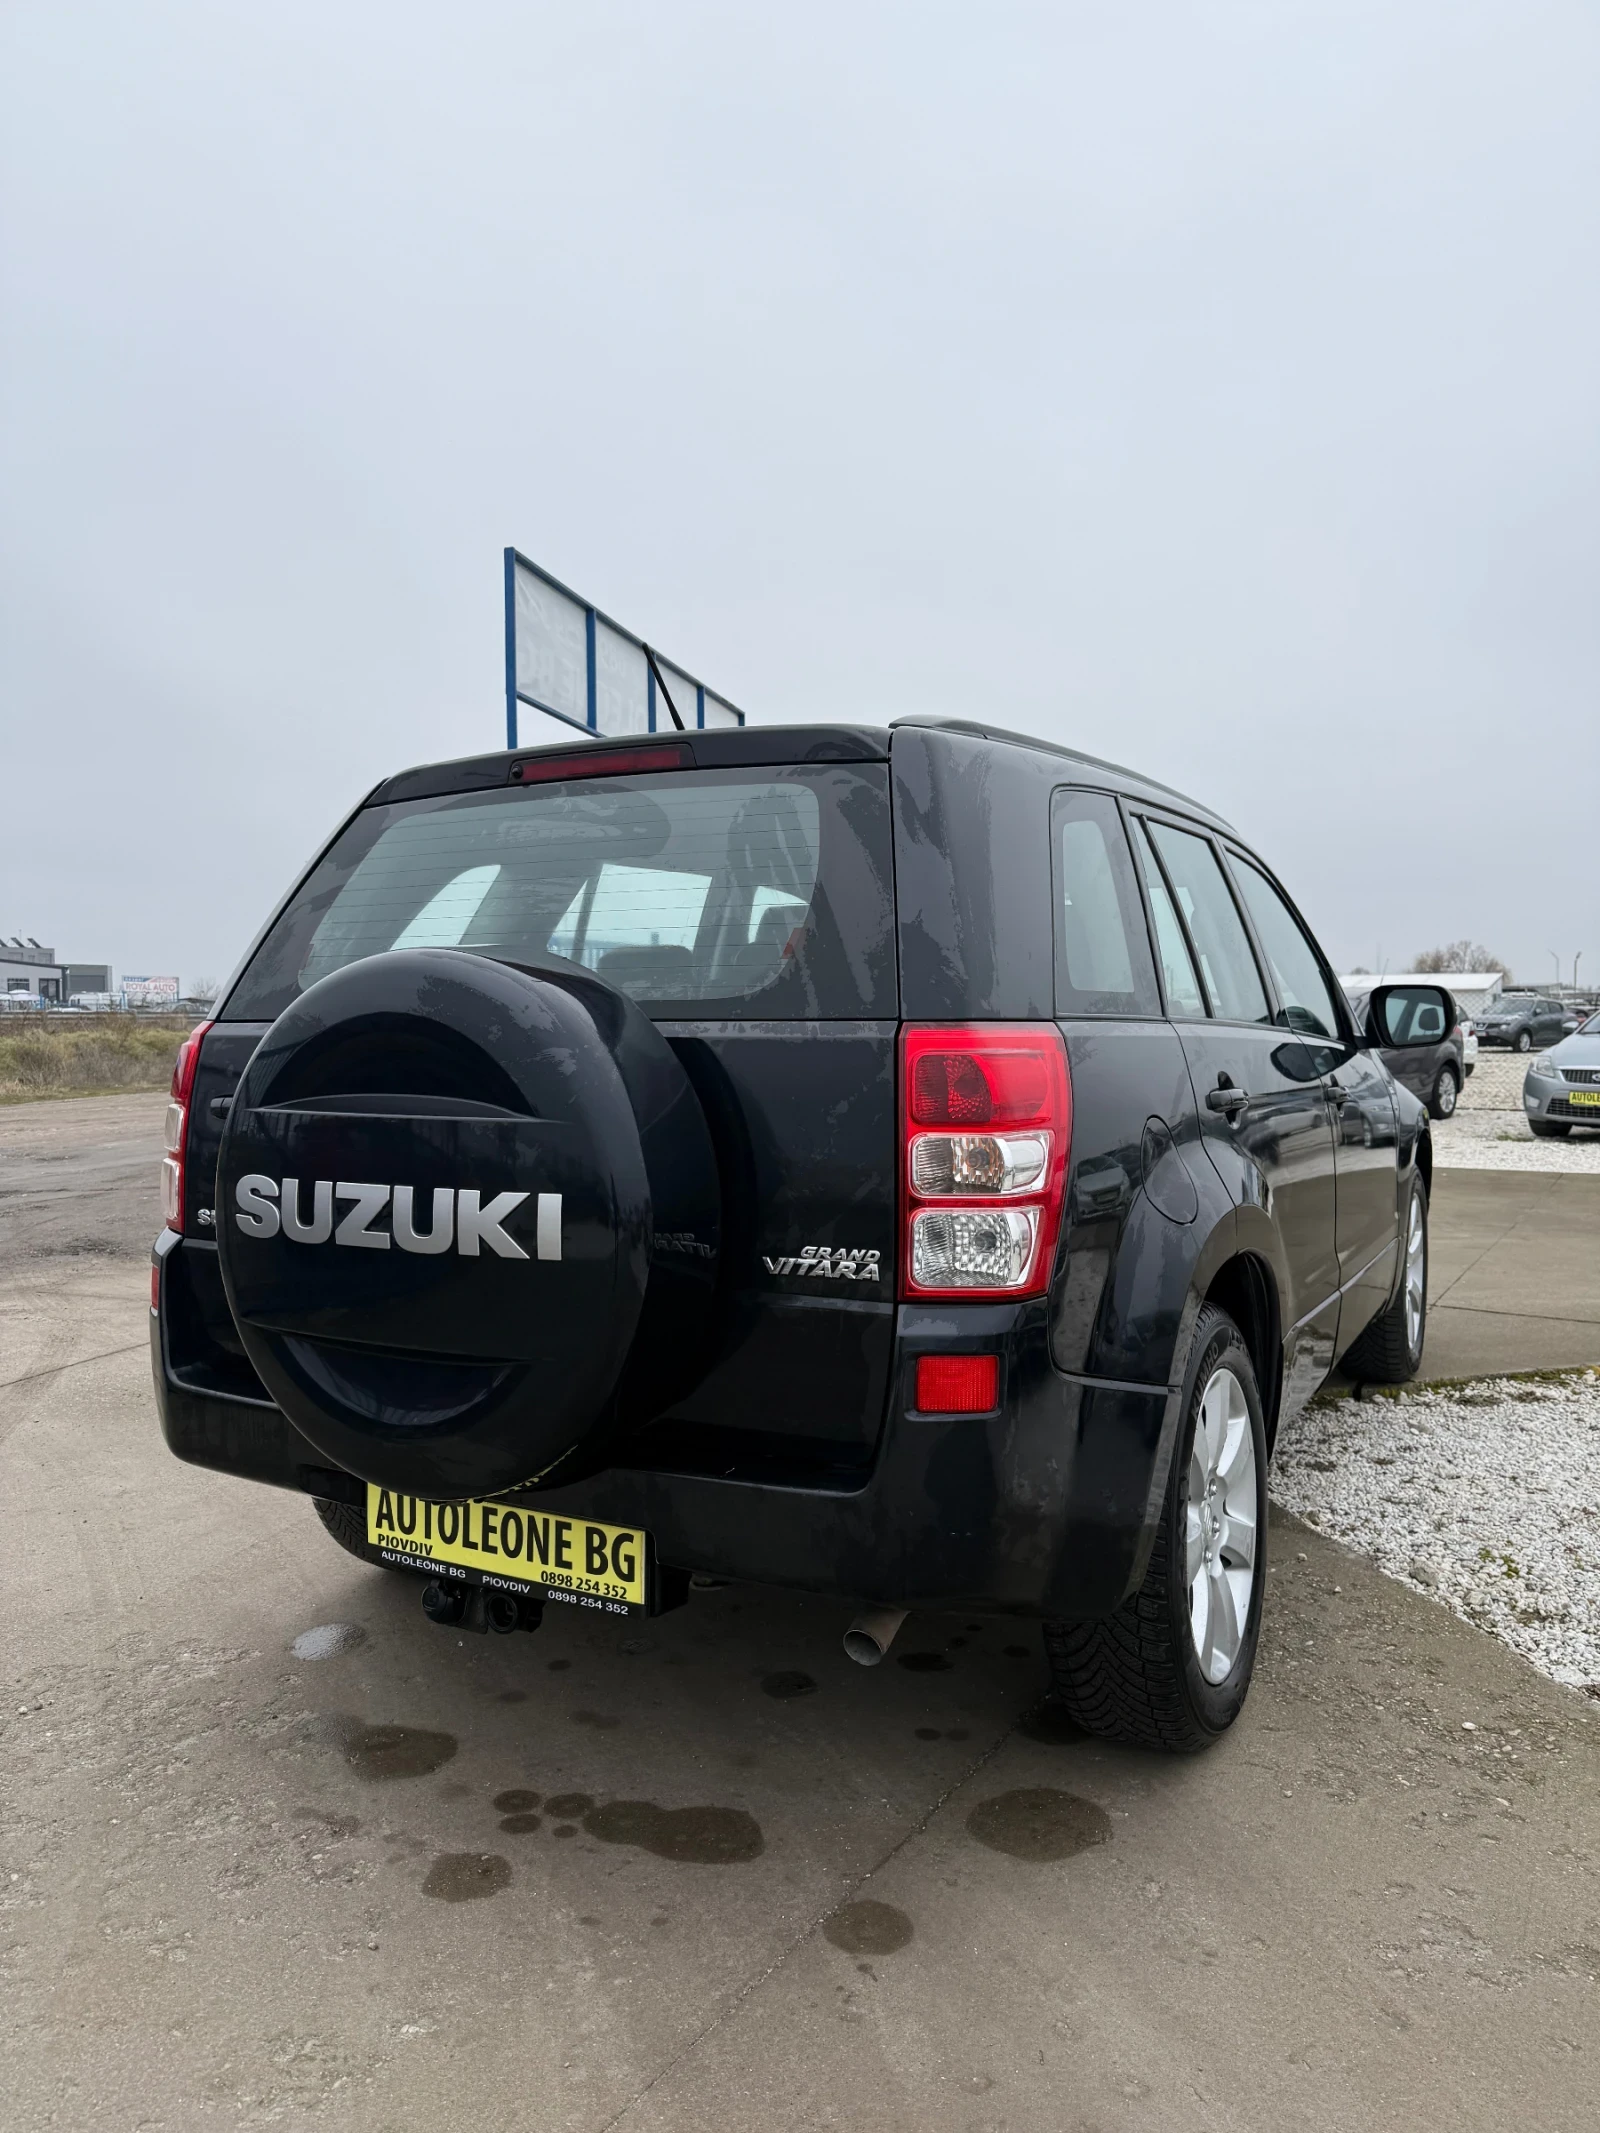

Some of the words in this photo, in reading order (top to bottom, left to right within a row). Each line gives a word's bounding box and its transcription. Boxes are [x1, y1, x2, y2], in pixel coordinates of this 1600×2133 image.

[126, 983, 152, 991] ROYAL
[153, 983, 175, 992] AUTO
[235, 1173, 563, 1261] SUZUKI
[800, 1245, 881, 1263] GRAND
[762, 1256, 880, 1282] VITARA
[375, 1488, 573, 1571] AUTOLEONE
[585, 1526, 635, 1583] BG
[377, 1533, 434, 1556] PIOVDIV
[381, 1550, 447, 1574] AUTOLEONE
[449, 1566, 466, 1579] BG
[482, 1575, 531, 1594] PIOVDIV
[547, 1589, 577, 1604] 0898
[580, 1596, 603, 1610] 254
[605, 1602, 629, 1615] 352
[540, 1570, 573, 1588] 0898
[576, 1576, 601, 1594] 254
[603, 1582, 628, 1600] 352
